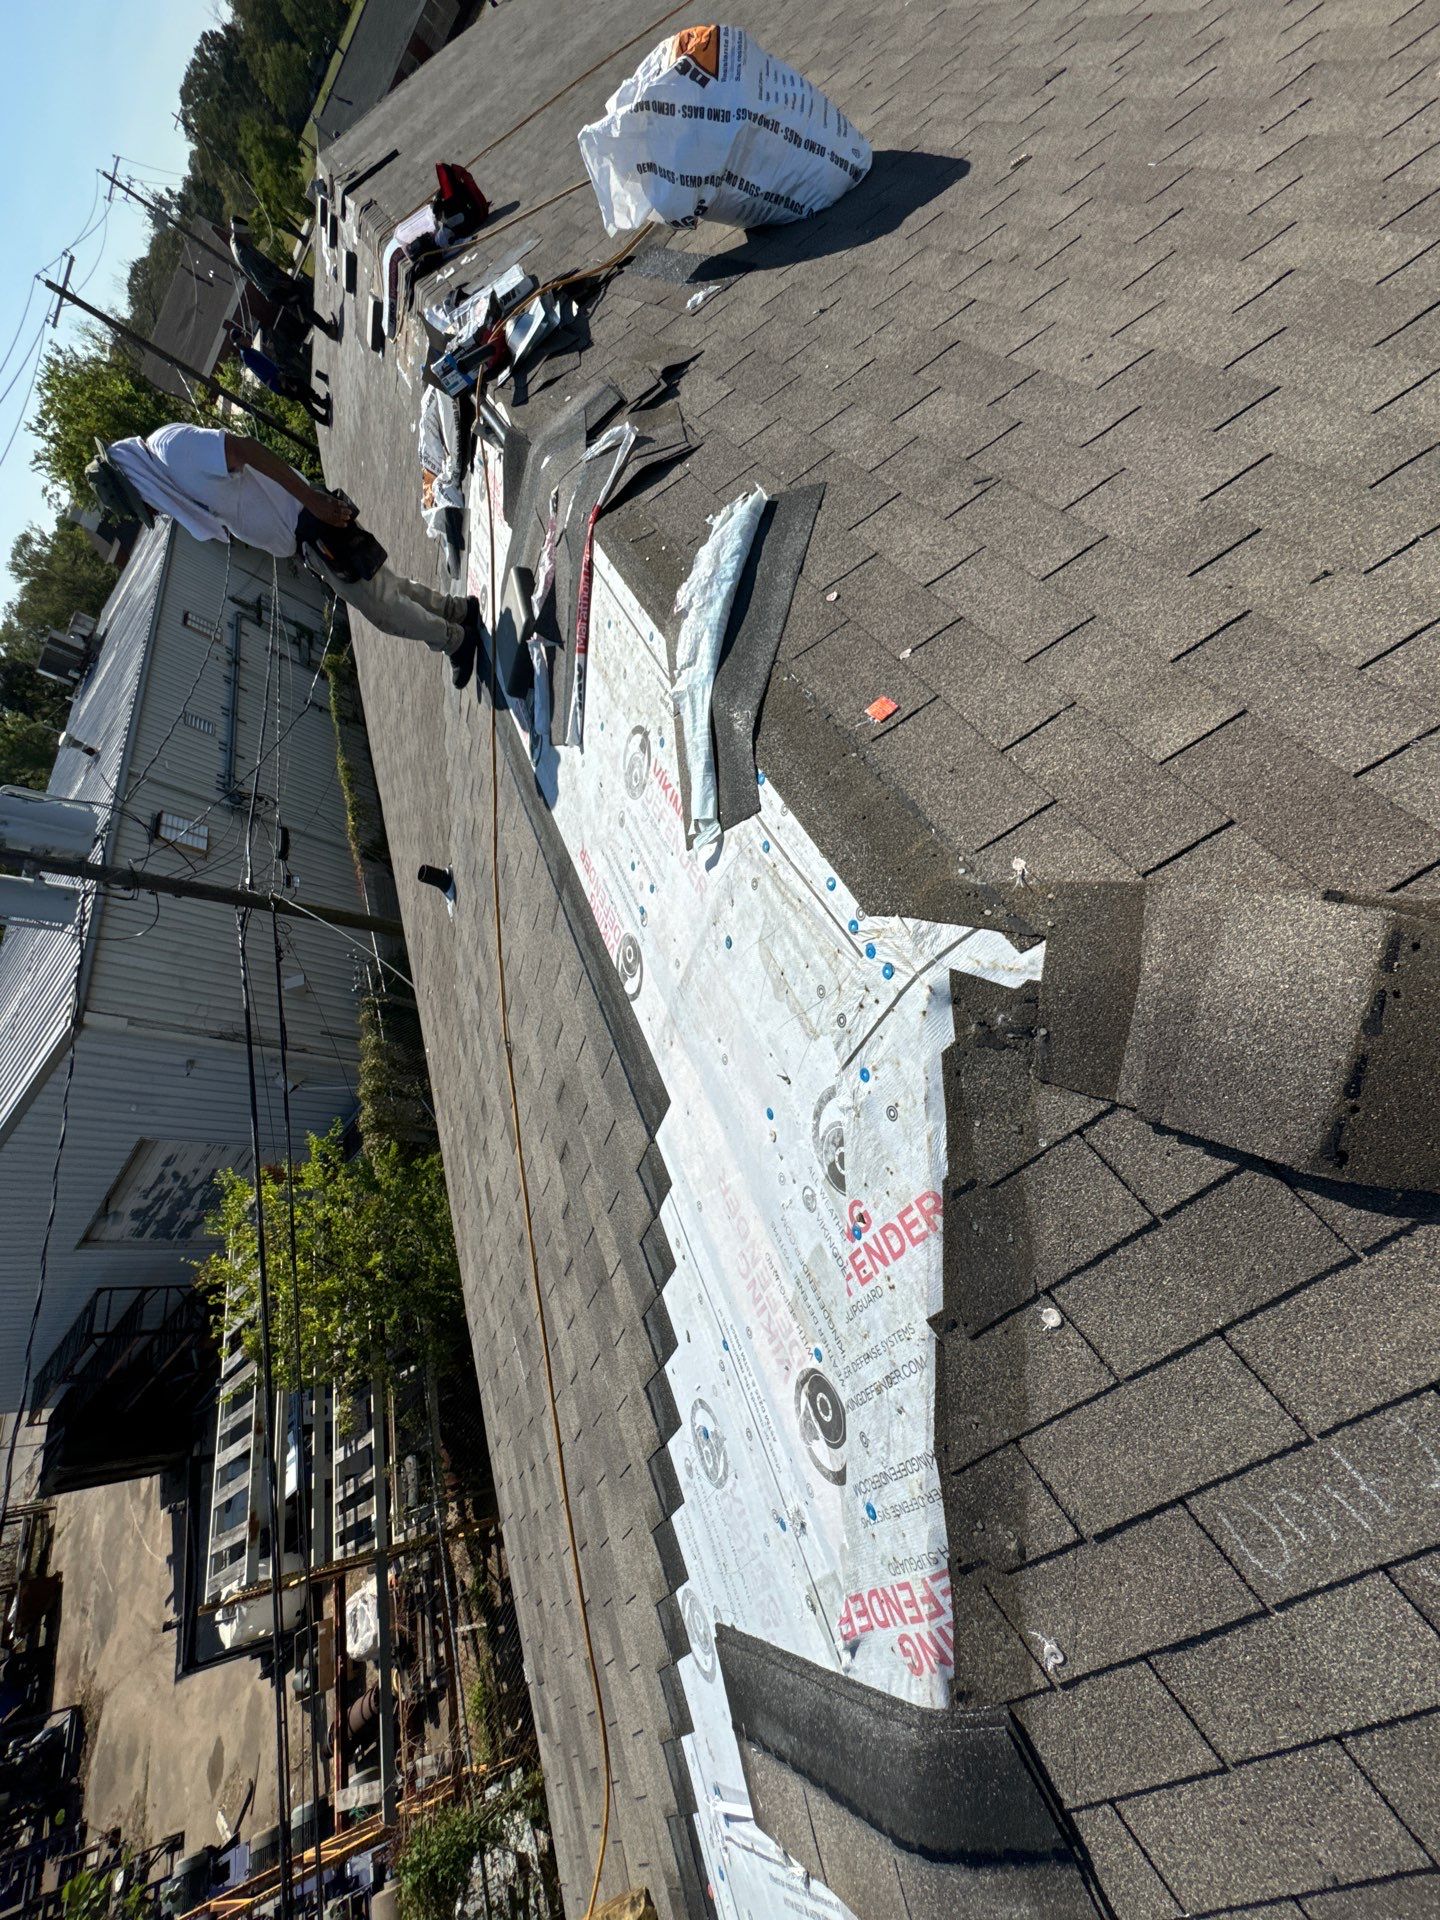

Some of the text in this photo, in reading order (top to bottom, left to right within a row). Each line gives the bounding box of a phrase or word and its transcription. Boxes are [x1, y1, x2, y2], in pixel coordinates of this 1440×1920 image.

[651, 101, 676, 116] DEMO
[681, 104, 705, 119] BAGS
[707, 107, 731, 123] DEMO
[758, 111, 781, 134] DEMO
[783, 126, 803, 148] BAGS
[804, 138, 827, 157] DEMO
[830, 150, 849, 172] BAGS
[636, 162, 658, 175] DEMO
[680, 174, 702, 188] DEMO
[738, 178, 761, 197] BAGS
[784, 198, 806, 215] BAGS
[576, 573, 591, 649] Marathon
[579, 844, 621, 944] DEFENDER
[851, 1344, 883, 1374] DEFENSE
[881, 1322, 916, 1351] SYSTEMS
[892, 1495, 926, 1519] DEFENSE
[887, 1551, 939, 1577] SLIPGUARD
